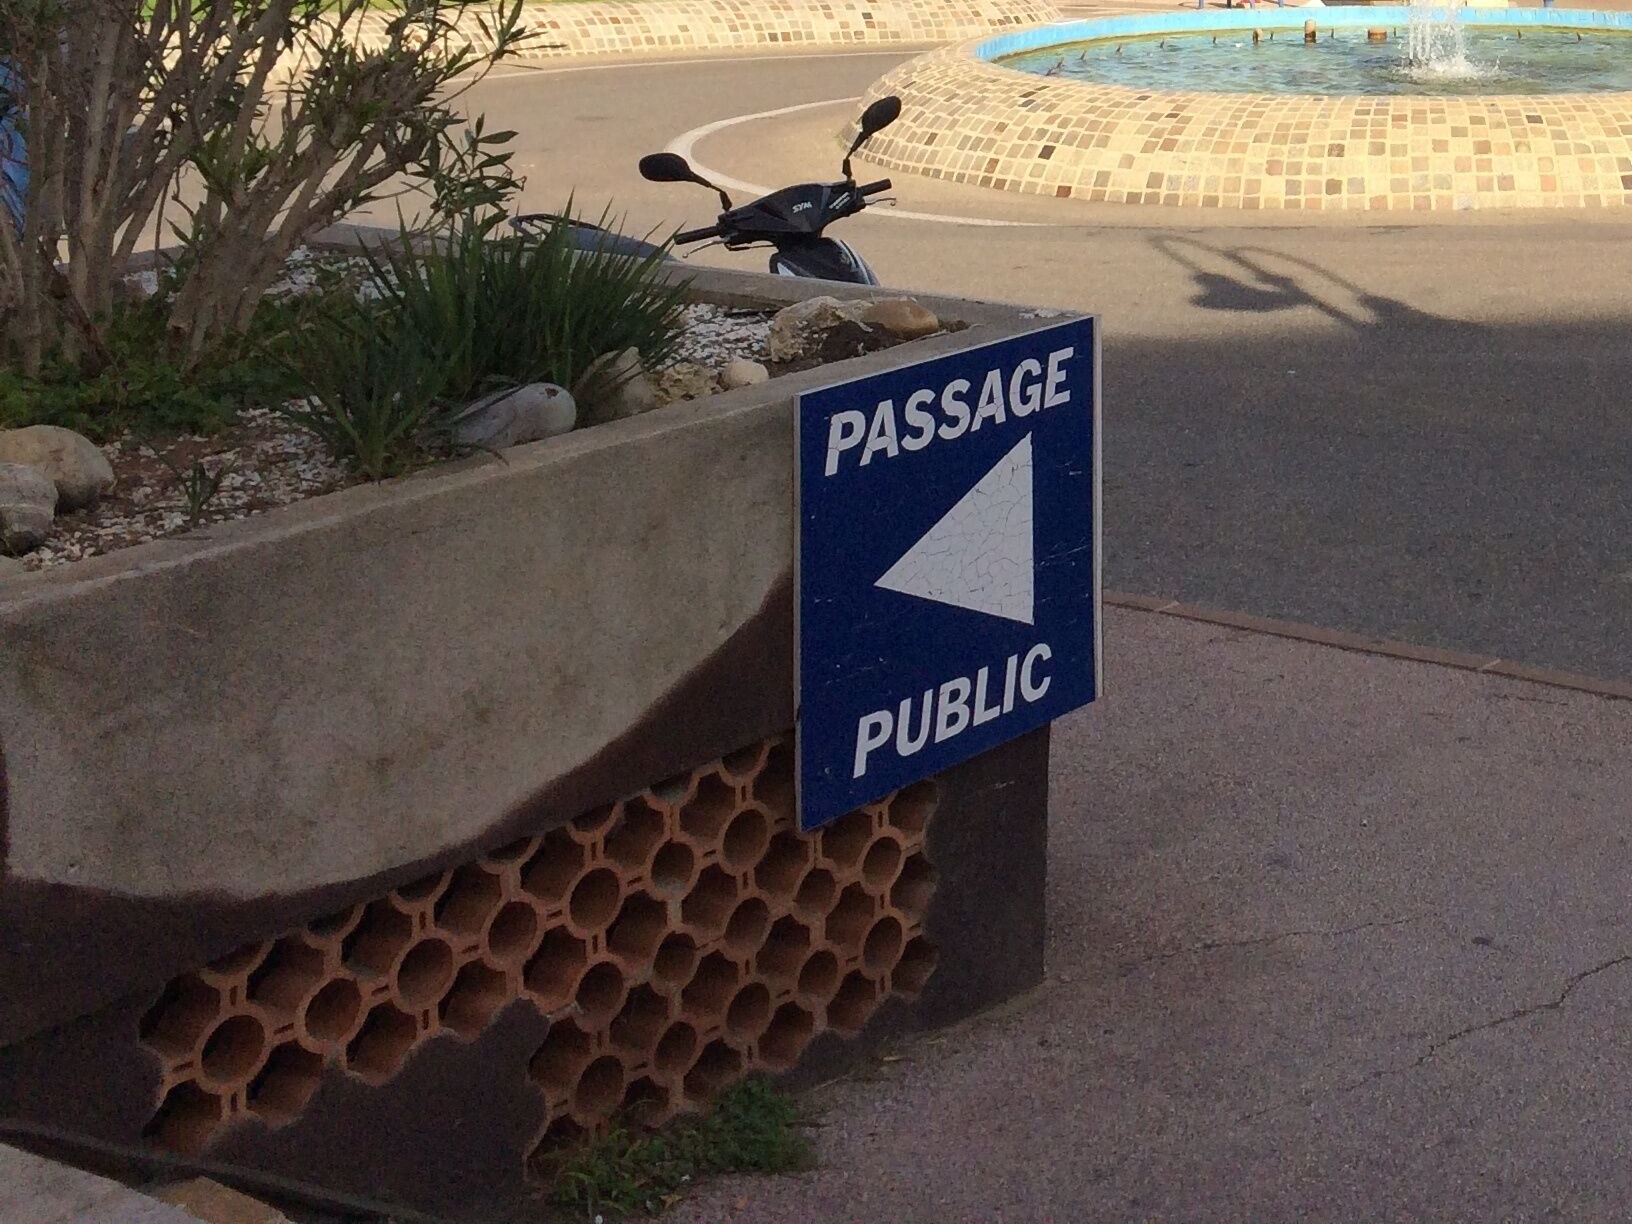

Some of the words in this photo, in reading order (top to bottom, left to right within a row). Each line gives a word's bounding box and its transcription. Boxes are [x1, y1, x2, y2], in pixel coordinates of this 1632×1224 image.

[792, 201, 812, 214] SYM
[825, 346, 1075, 477] PASSAGE
[853, 642, 1052, 779] PUBLIC
